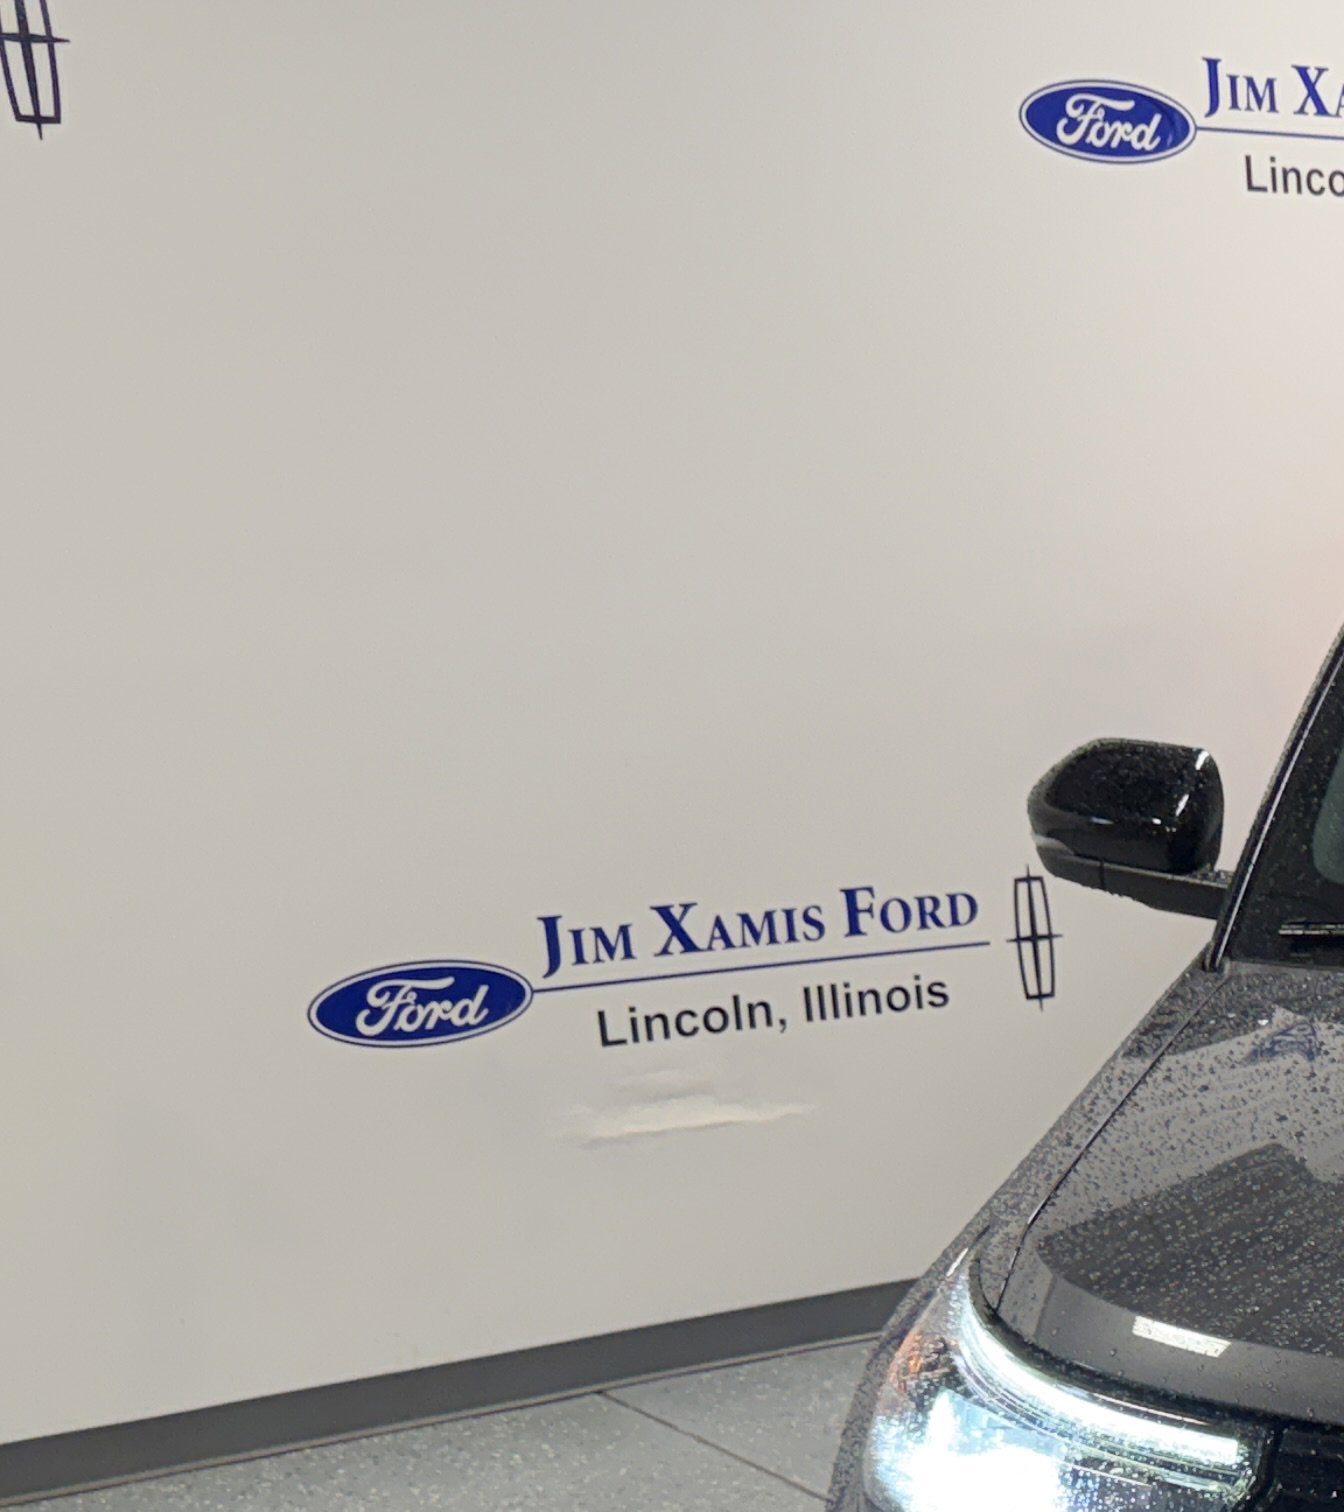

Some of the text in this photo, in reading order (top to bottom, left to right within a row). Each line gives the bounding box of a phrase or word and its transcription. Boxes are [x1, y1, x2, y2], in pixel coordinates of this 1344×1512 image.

[1056, 92, 1162, 152] Ford
[354, 976, 489, 1038] Ford
[597, 975, 950, 1048] Lincoln, Illinois
